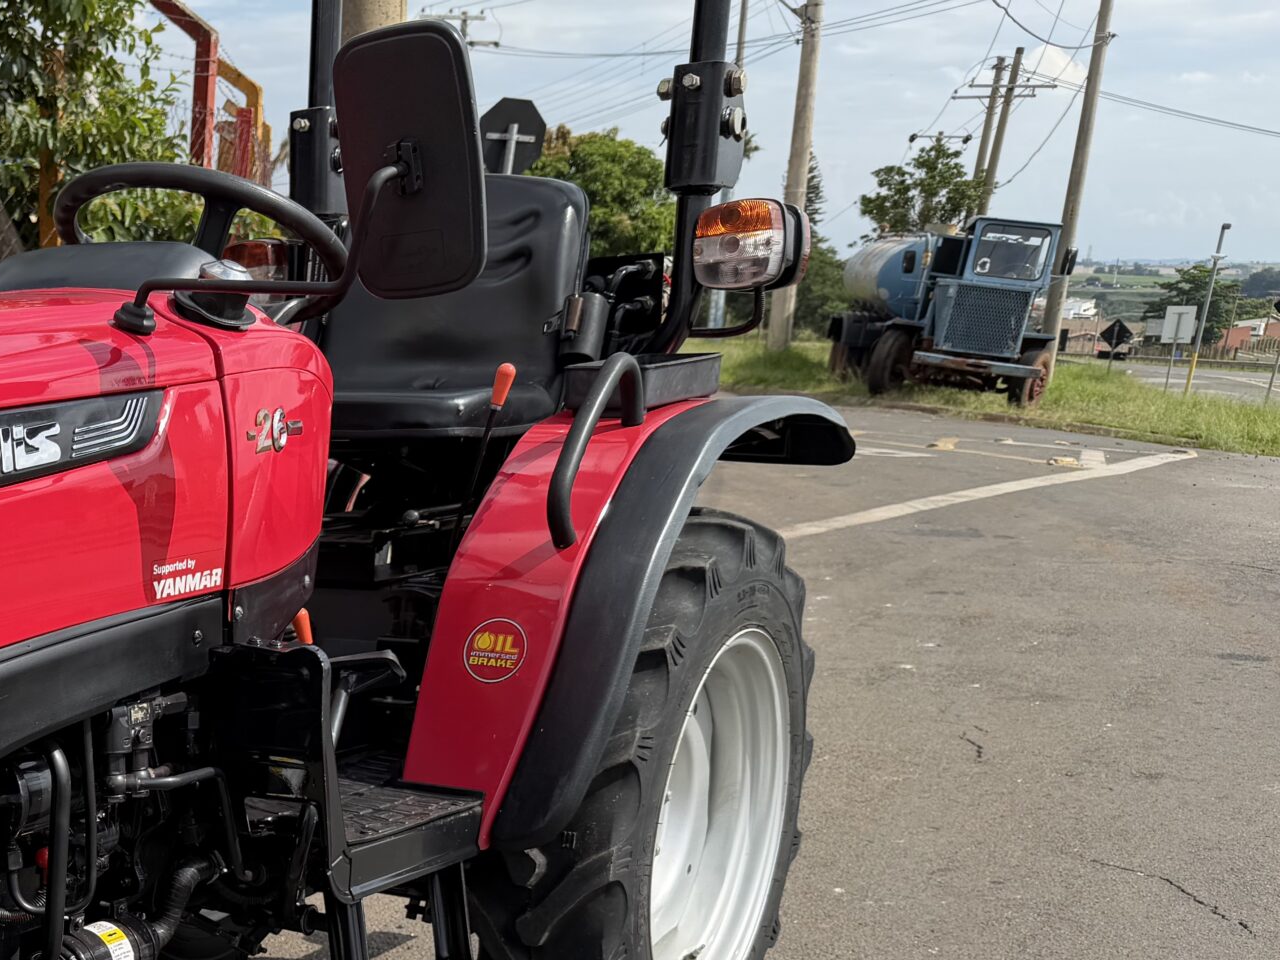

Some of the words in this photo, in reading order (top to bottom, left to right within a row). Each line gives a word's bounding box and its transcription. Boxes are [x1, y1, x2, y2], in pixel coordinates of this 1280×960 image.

[153, 559, 186, 576] Supported
[187, 558, 196, 570] by
[153, 567, 223, 600] YANMAR
[473, 631, 519, 653] OIL
[469, 656, 516, 669] BRAKE
[471, 651, 518, 660] immersed
